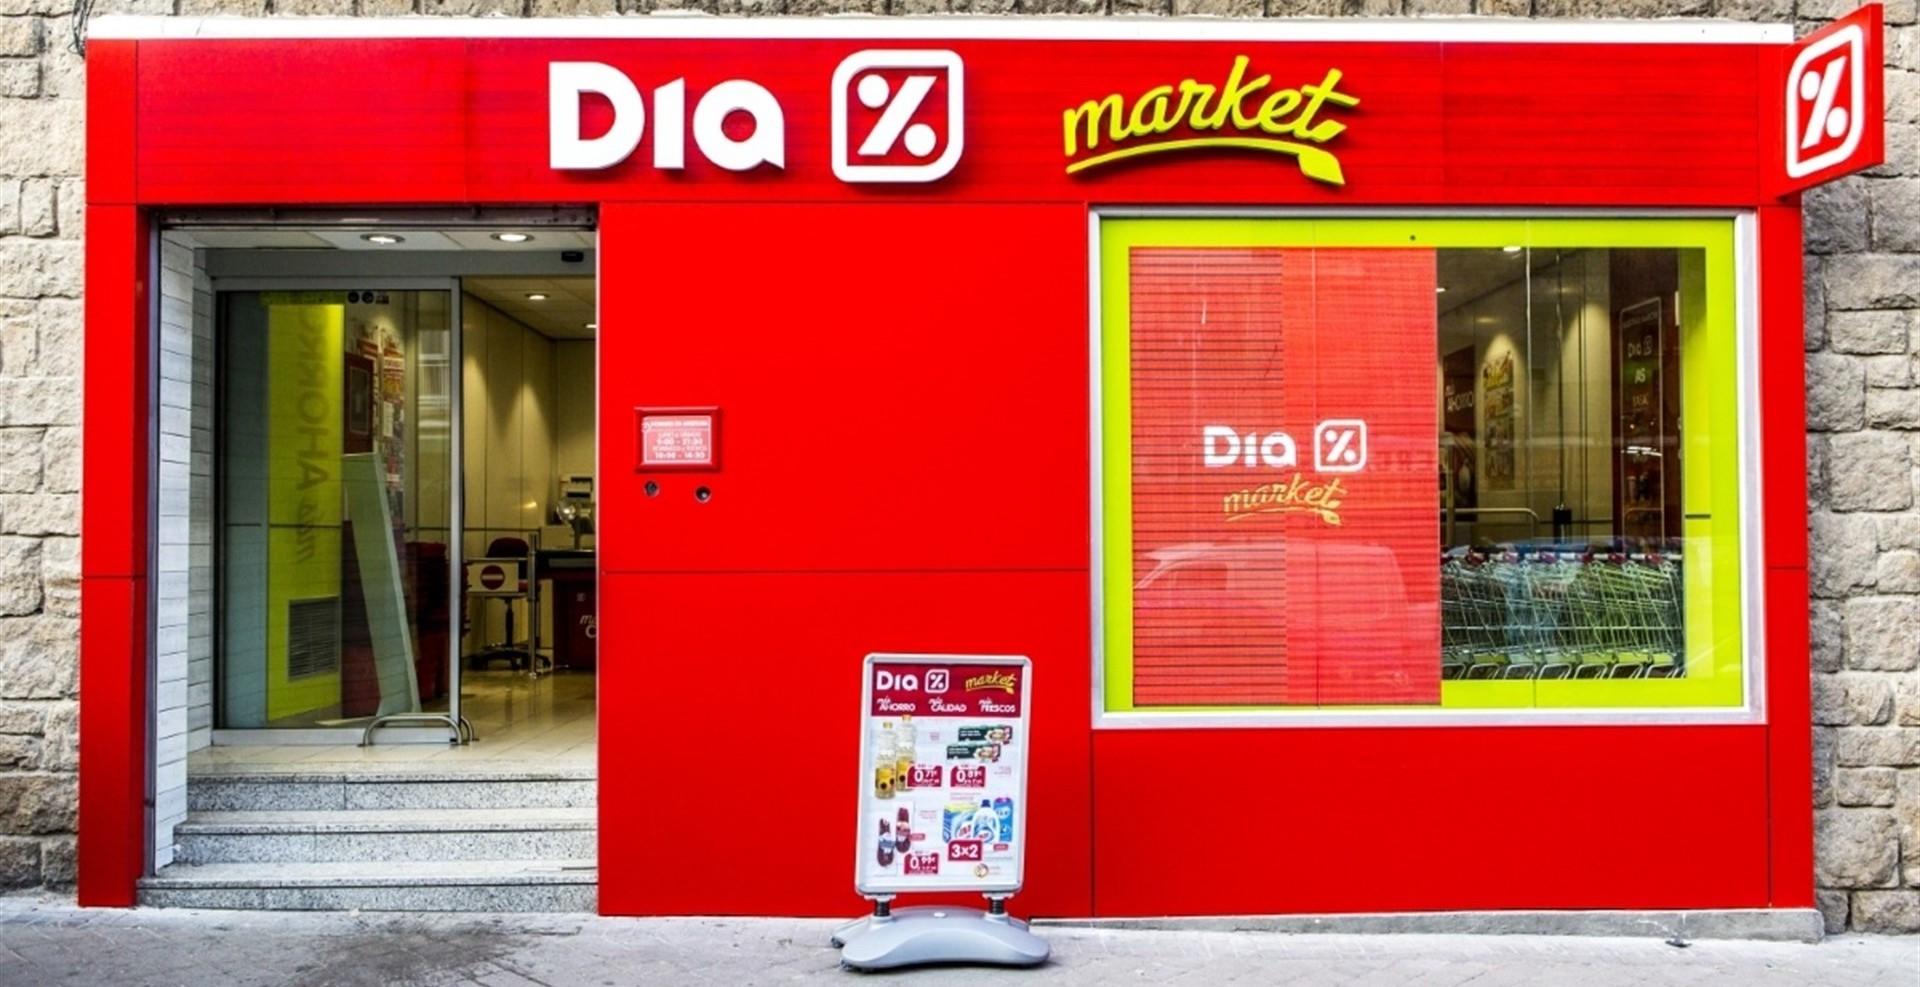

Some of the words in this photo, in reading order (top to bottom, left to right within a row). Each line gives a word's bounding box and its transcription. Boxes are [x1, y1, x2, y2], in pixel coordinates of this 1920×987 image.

[1064, 55, 1360, 158] market
[1223, 472, 1349, 513] market
[965, 670, 1017, 690] market
[879, 702, 916, 712] AHORRO
[930, 703, 967, 713] CALIDAD
[980, 703, 1016, 713] FRESCOS
